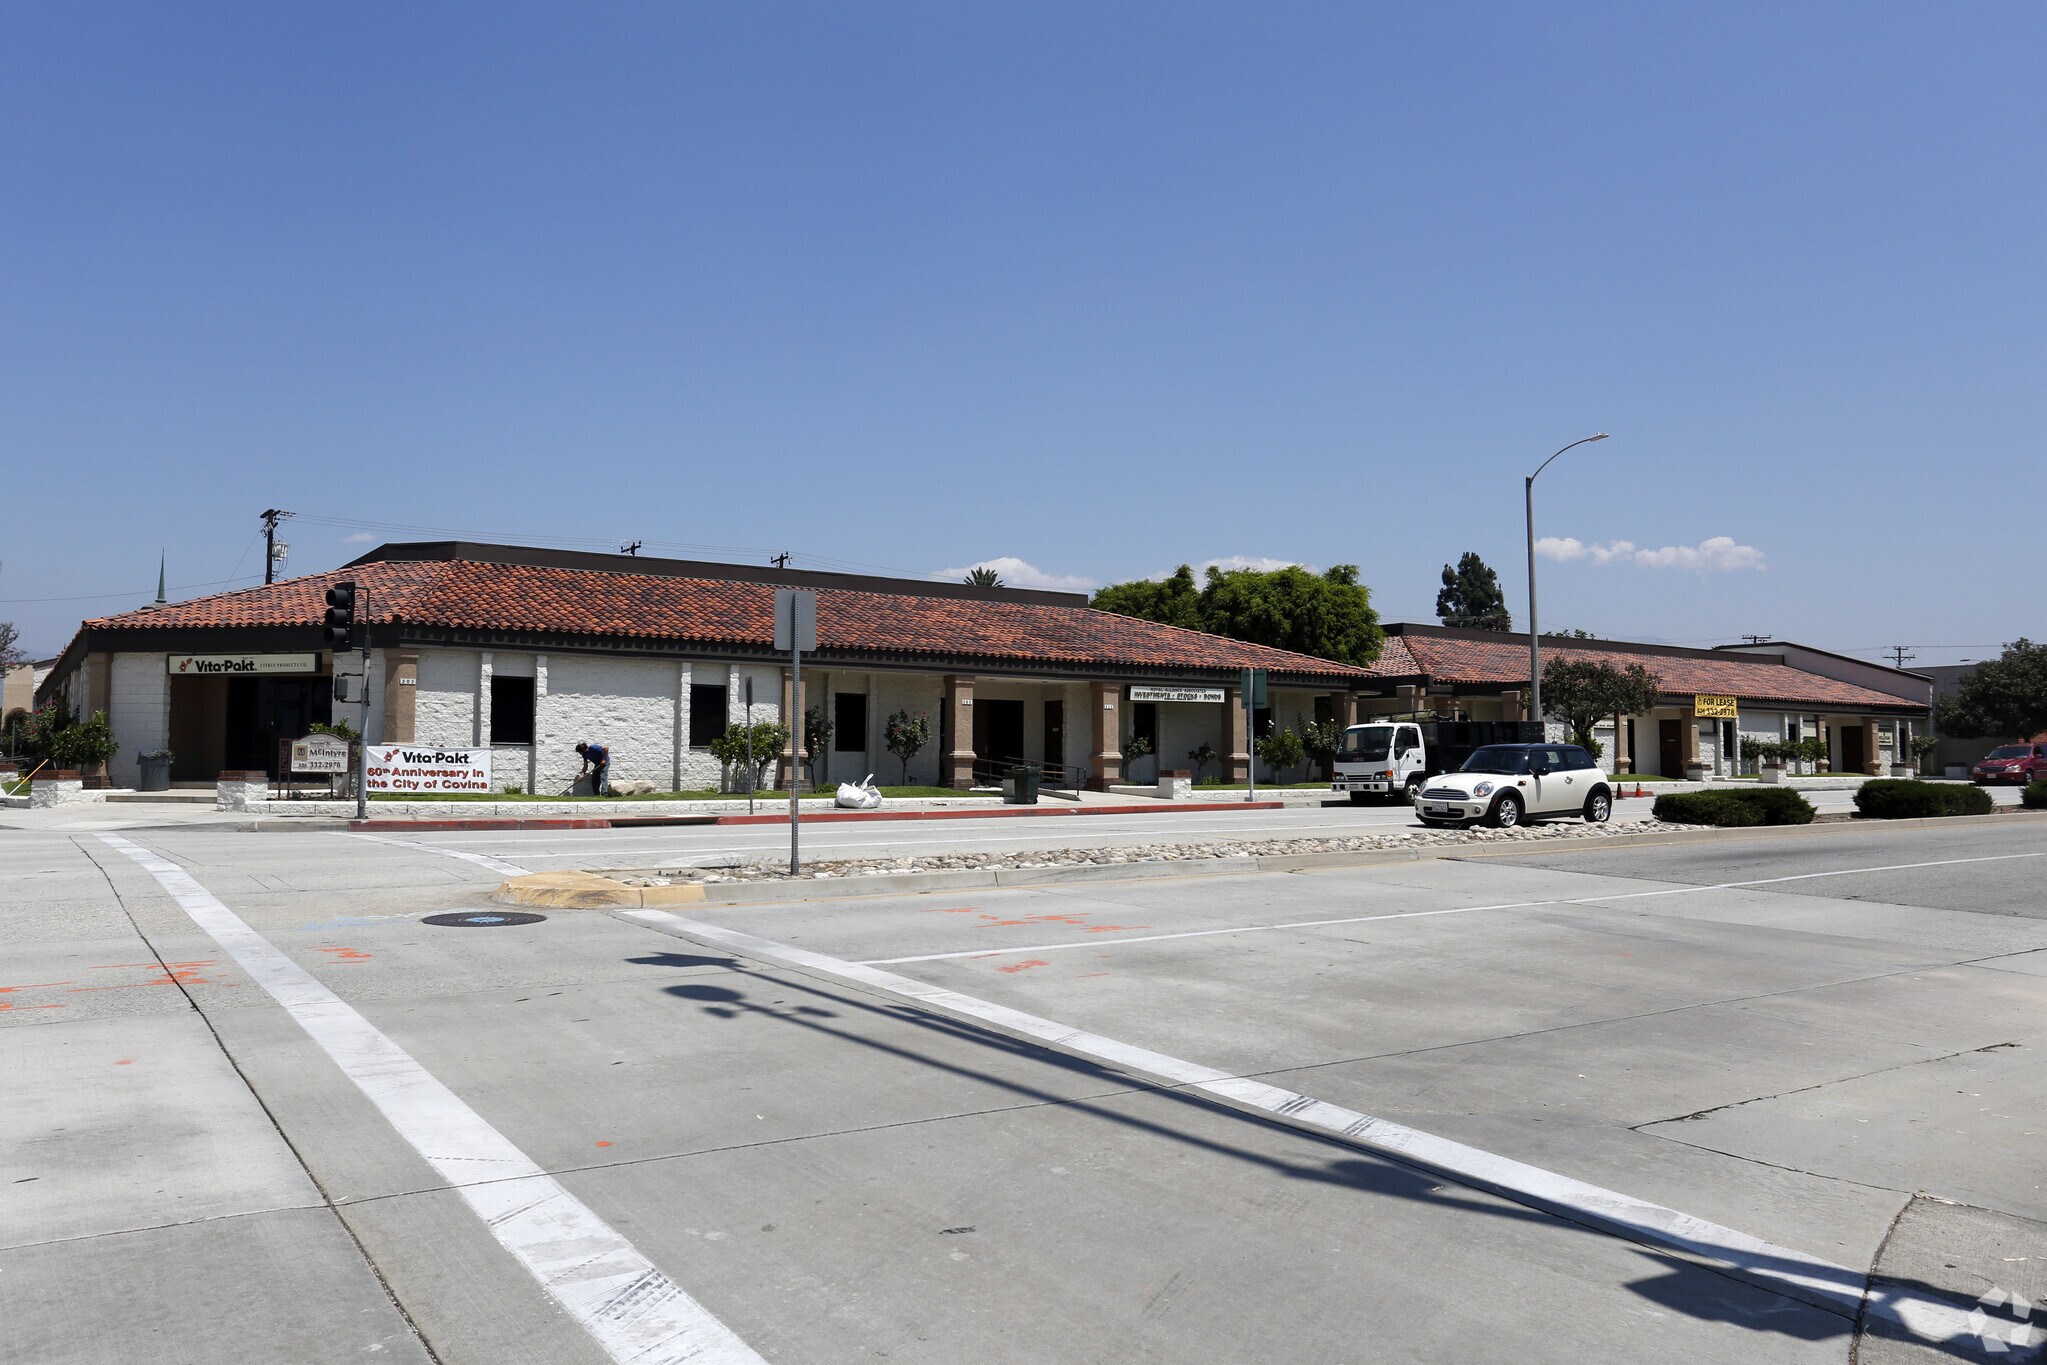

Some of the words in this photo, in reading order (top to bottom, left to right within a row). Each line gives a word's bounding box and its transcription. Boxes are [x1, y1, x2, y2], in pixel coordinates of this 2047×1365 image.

[195, 660, 255, 672] Vita-Pakt
[309, 748, 347, 757] McIntyre
[402, 752, 470, 764] Vita-Pakt
[310, 761, 341, 769] 332-2978
[367, 767, 390, 777] 60th
[391, 767, 469, 779] Anniversary
[472, 768, 485, 777] in
[366, 779, 388, 788] the
[392, 779, 419, 790] City
[423, 780, 438, 789] of
[441, 780, 488, 789] Covina
